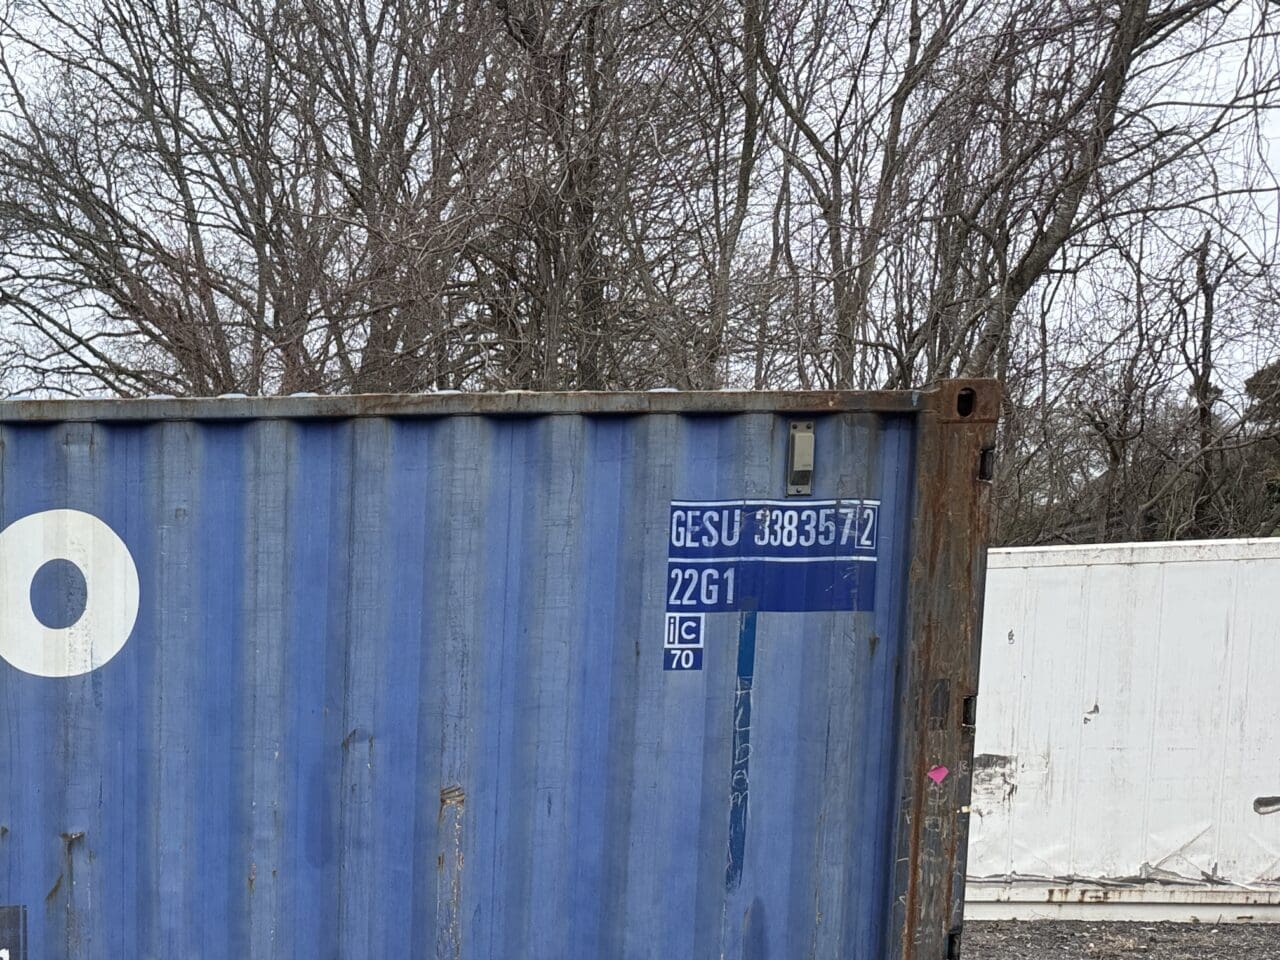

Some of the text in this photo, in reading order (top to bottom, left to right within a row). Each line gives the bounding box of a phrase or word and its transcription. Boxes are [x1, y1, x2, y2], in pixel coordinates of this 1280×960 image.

[671, 508, 741, 548] GESU
[668, 567, 736, 606] 22G1
[671, 650, 695, 669] 70
